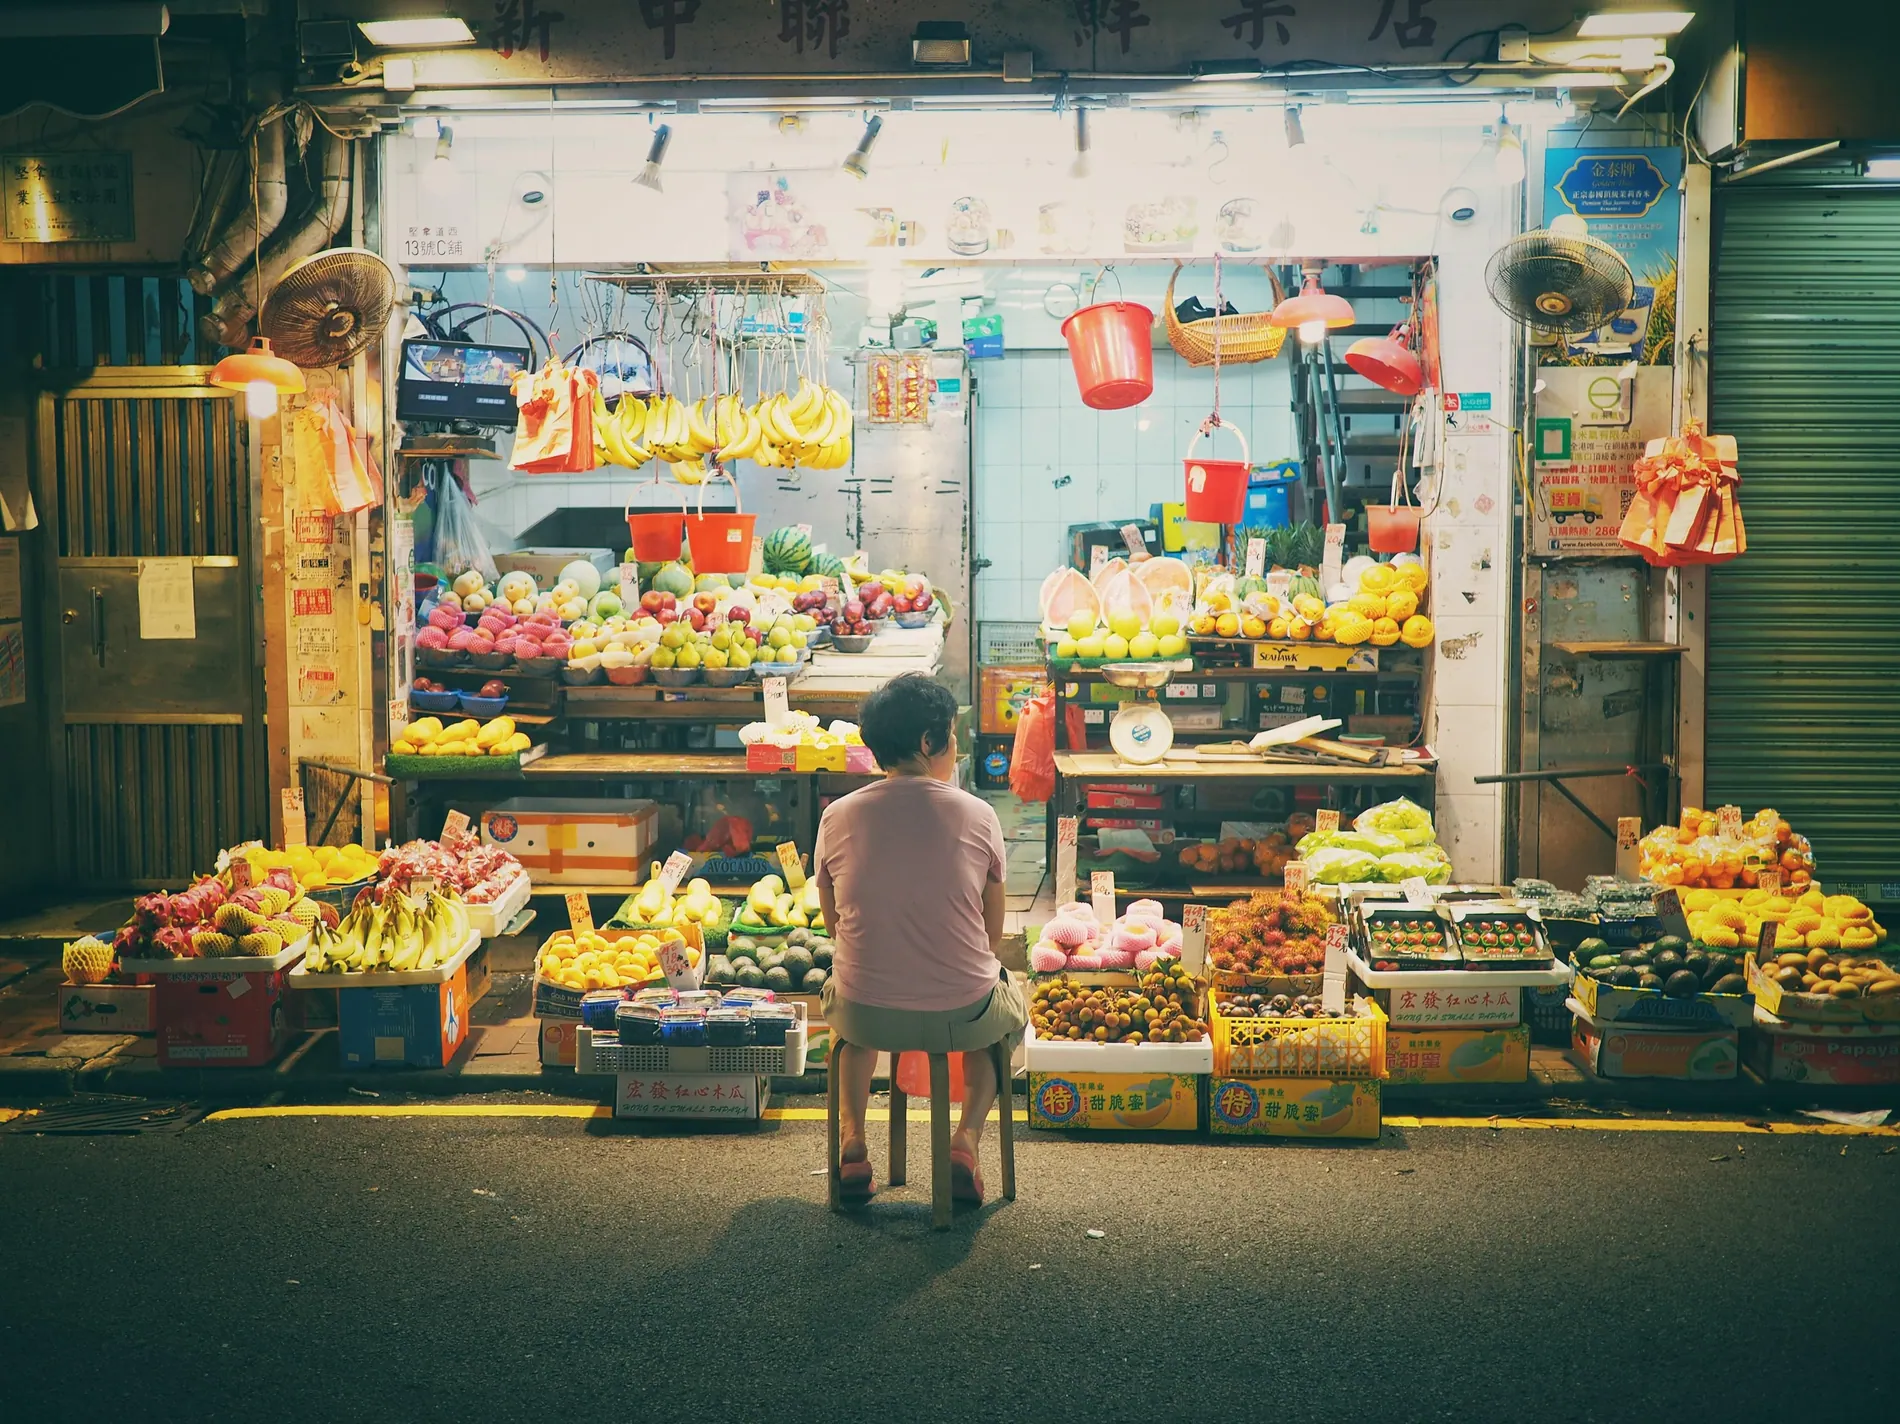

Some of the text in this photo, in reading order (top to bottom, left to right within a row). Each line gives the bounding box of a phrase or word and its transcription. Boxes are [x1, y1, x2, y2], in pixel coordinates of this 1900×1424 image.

[1592, 162, 1635, 177] 金泰牌
[409, 227, 458, 237] 堅拿道西
[1552, 492, 1580, 507] 送貨
[707, 861, 768, 874] AVOCADOS
[1396, 1014, 1422, 1022] HONG
[1440, 1013, 1474, 1021] SMALL
[1478, 1012, 1515, 1021] PAPAYA
[1640, 1001, 1712, 1019] AVOCADOS
[1827, 1043, 1900, 1057] Papaya
[1044, 1087, 1073, 1115] 特
[1089, 1094, 1145, 1112] 甜脆蜜
[1222, 1088, 1252, 1118] 特
[623, 1104, 649, 1114] HONG
[669, 1103, 705, 1114] SMALL
[709, 1105, 749, 1115] PAPAYA
[1264, 1102, 1321, 1123] 甜脆蜜
